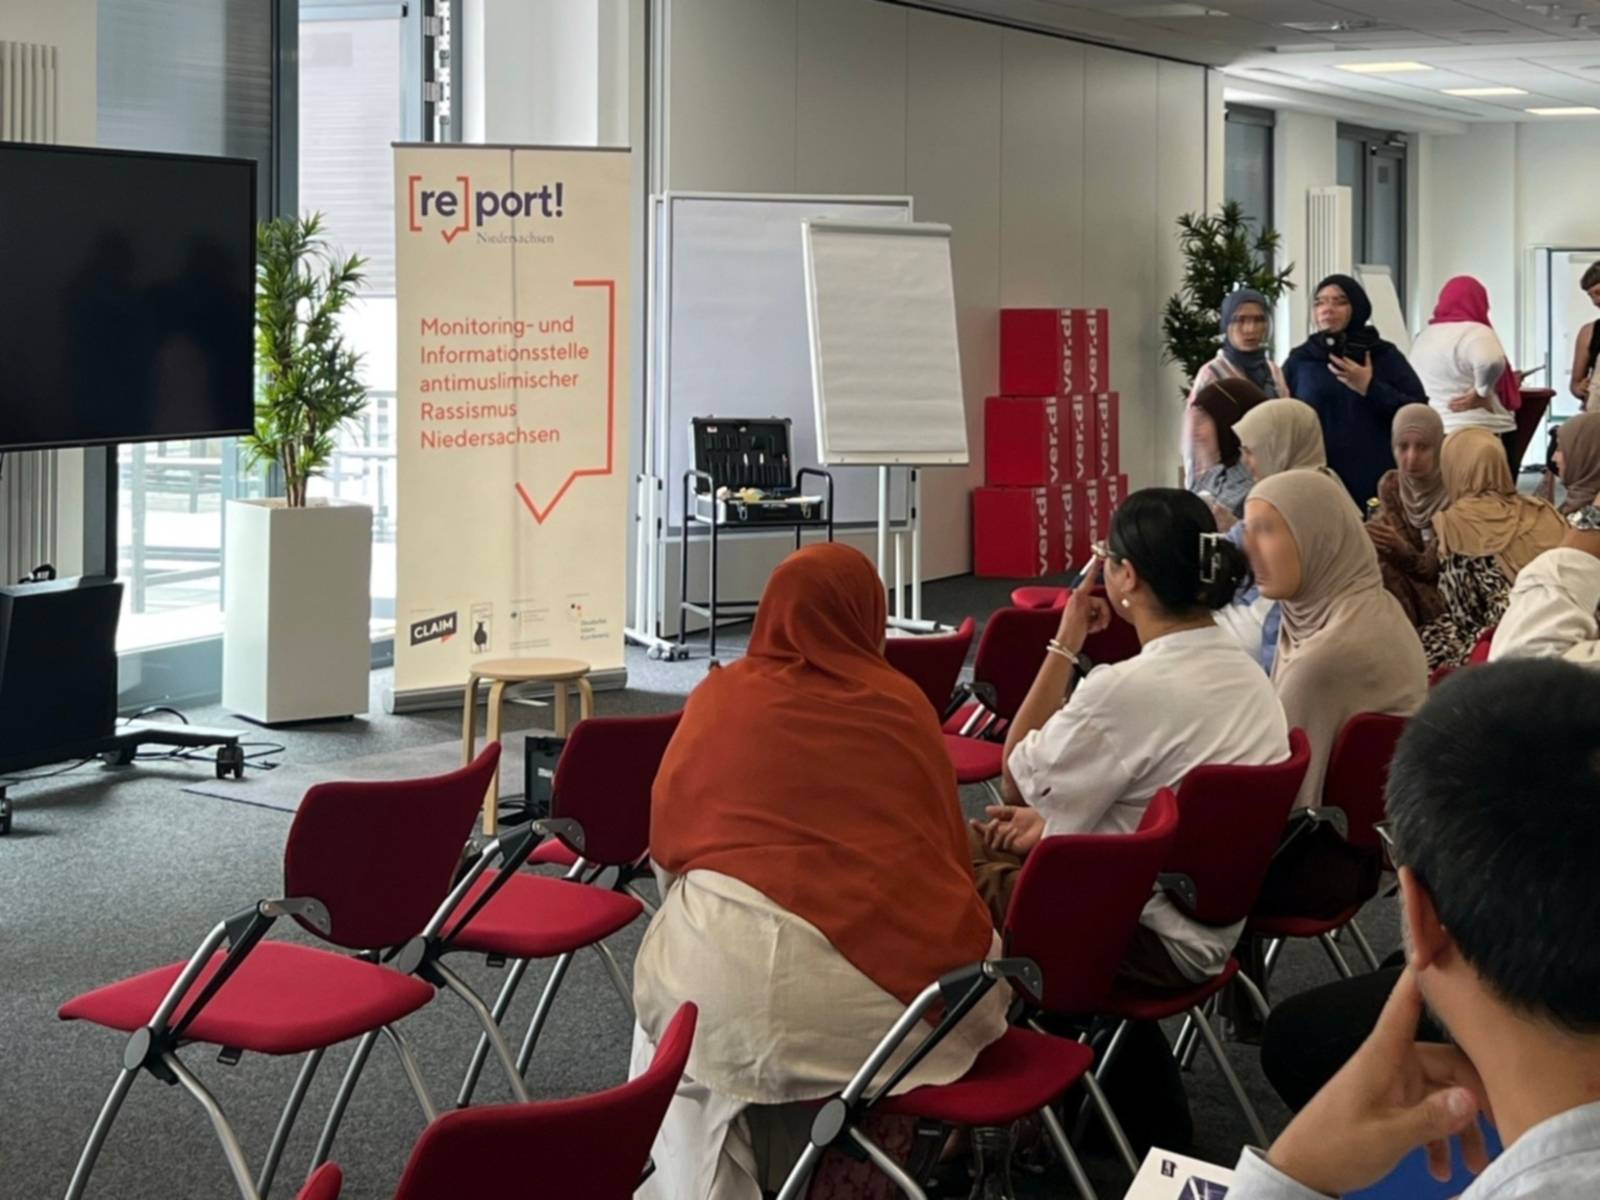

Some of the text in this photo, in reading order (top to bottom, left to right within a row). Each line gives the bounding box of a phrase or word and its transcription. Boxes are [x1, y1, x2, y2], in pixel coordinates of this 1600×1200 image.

[420, 316, 574, 338] Monitoring- und
[420, 343, 589, 364] Informationsstelle
[1061, 310, 1072, 395] ver.di
[1086, 309, 1097, 393] ver.di
[420, 371, 579, 393] antimuslimischer
[421, 401, 518, 421] Rassismus
[421, 427, 560, 449] Niedersachsen
[1046, 397, 1058, 483] ver.di
[1073, 395, 1084, 479] ver.di
[1098, 394, 1109, 476] ver.di
[1036, 487, 1048, 576] ver.di
[1062, 484, 1073, 571] ver.di
[1087, 480, 1098, 545] er.di
